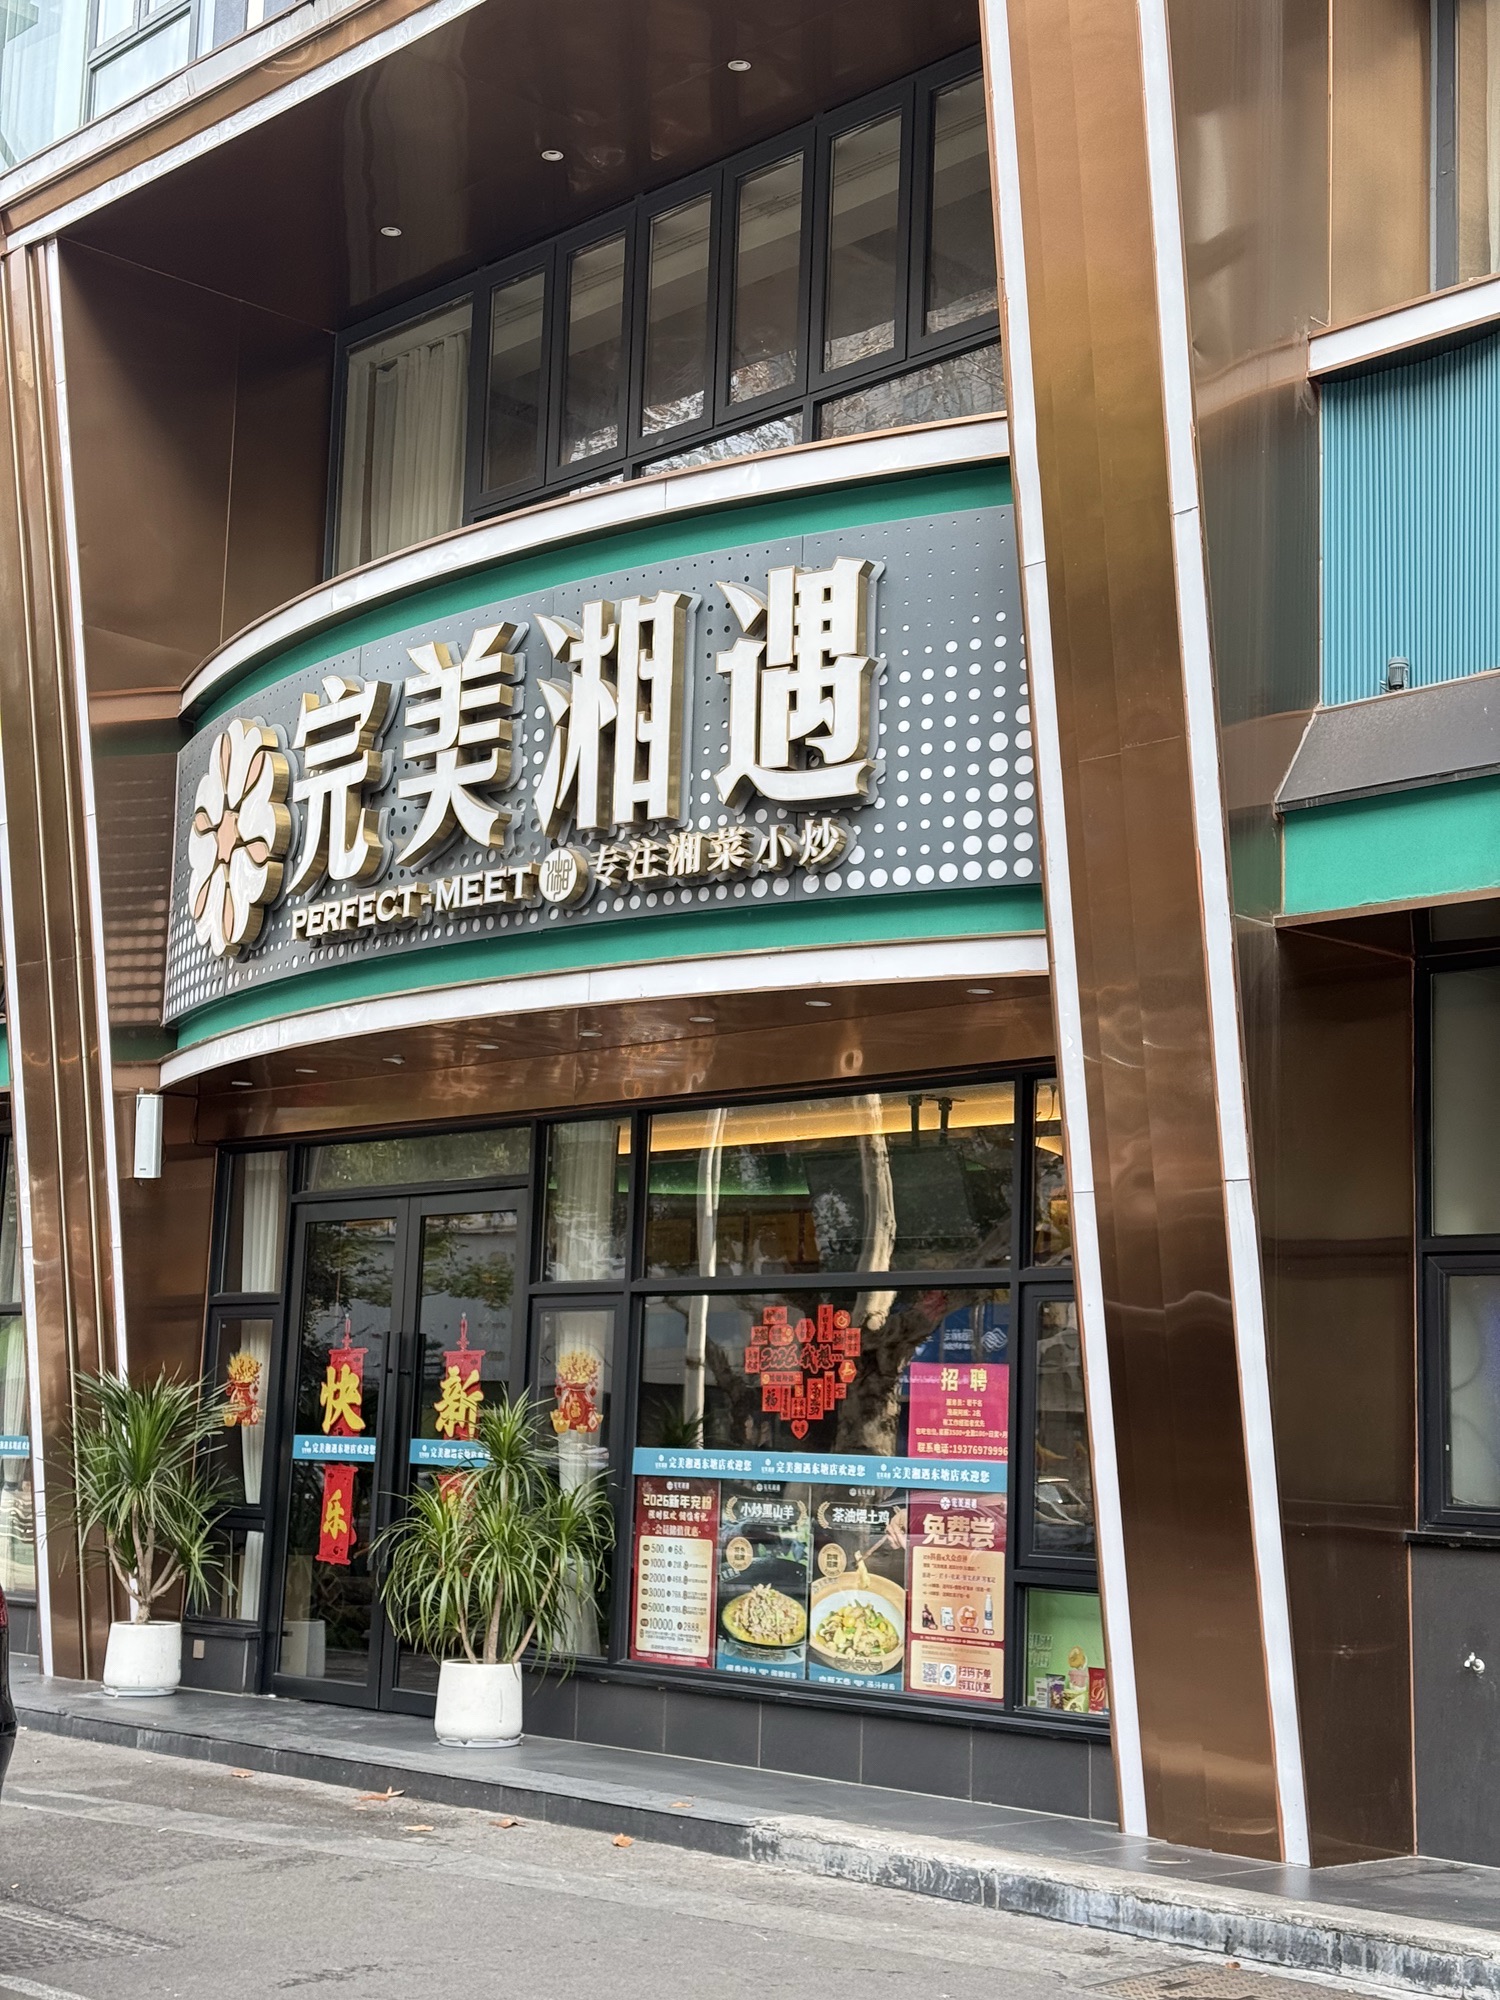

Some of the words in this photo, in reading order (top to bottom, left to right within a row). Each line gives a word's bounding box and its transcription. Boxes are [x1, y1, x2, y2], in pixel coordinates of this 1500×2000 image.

[286, 555, 876, 895] 完美湘遇
[590, 819, 842, 887] 专注湘菜小炒
[941, 1367, 988, 1392] 招聘
[320, 1363, 366, 1434] 快
[433, 1365, 484, 1438] 新
[668, 1456, 752, 1472] 完美湘遇东塘店欢迎您
[776, 1460, 866, 1478] 完美湘遇东塘店欢迎您
[892, 1466, 990, 1484] 完美湘遇东塘店欢迎您
[322, 1489, 347, 1540] 乐
[740, 1502, 794, 1520] 小炒黑山羊
[922, 1513, 995, 1549] 免费尝
